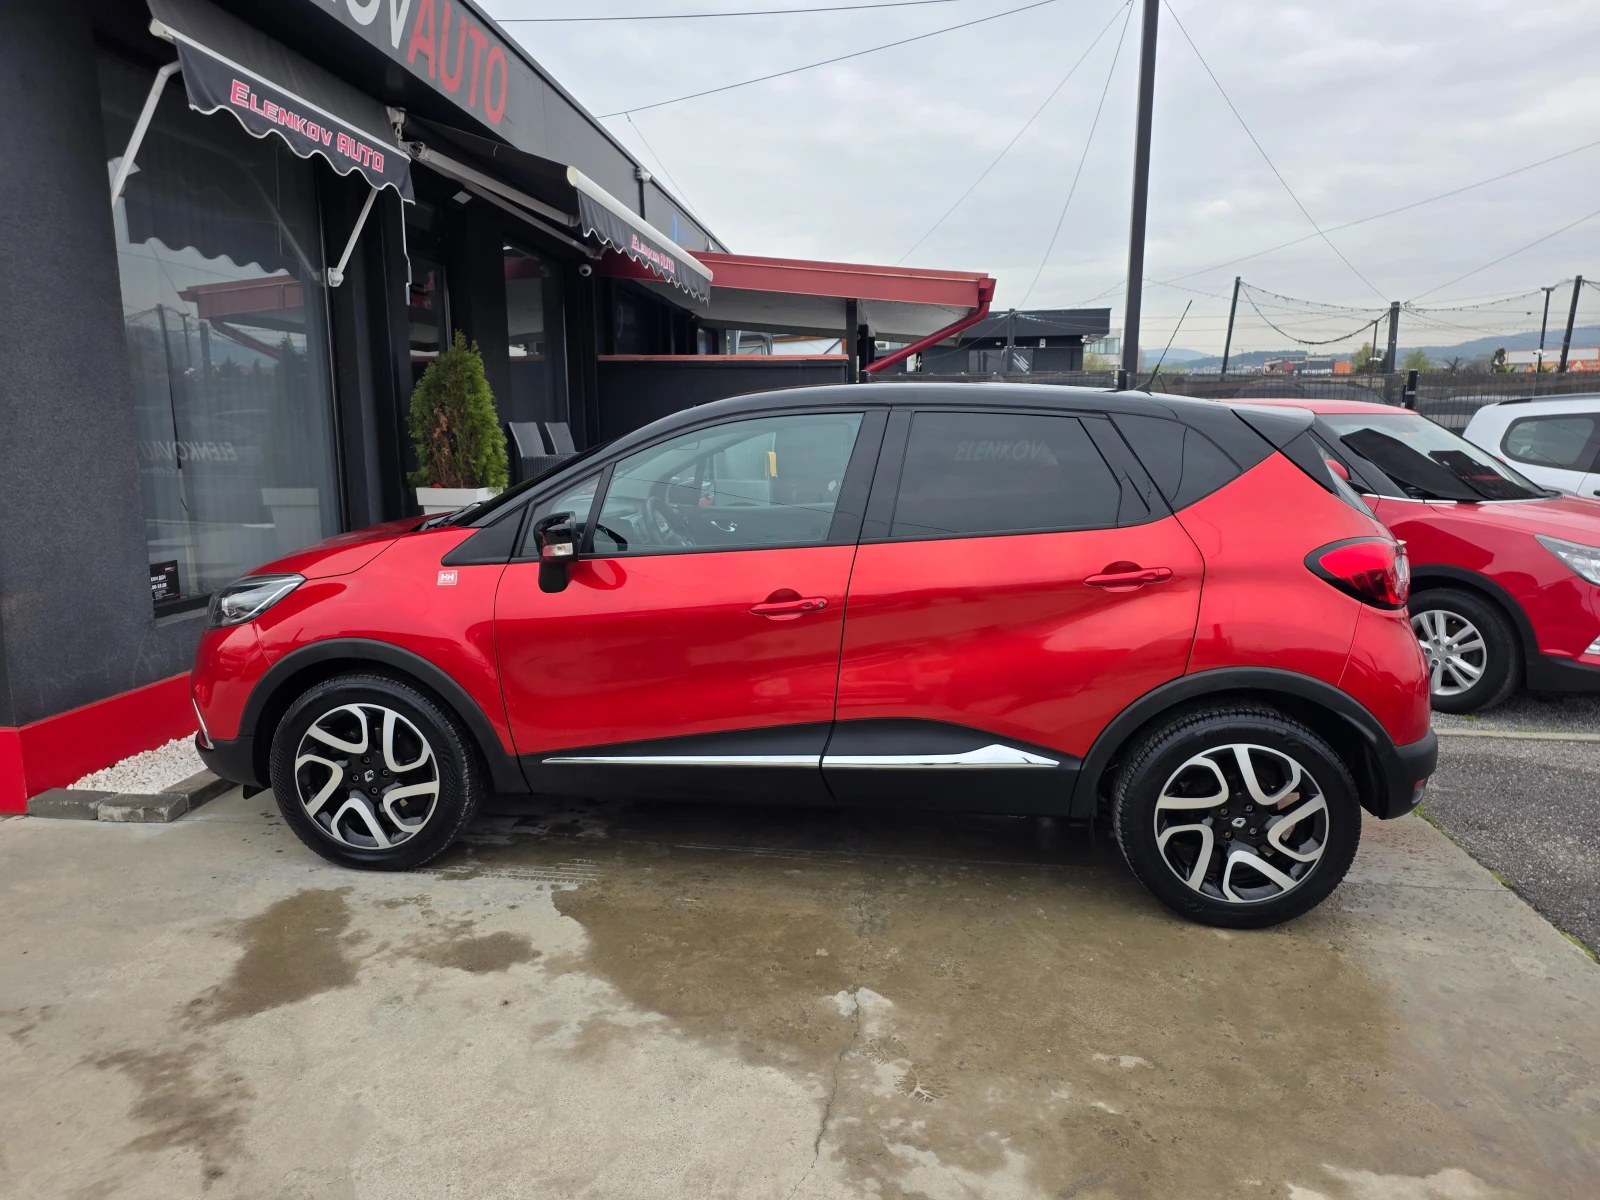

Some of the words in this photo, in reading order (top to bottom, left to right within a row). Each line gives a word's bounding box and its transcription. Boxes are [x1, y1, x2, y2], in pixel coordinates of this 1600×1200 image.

[230, 79, 332, 147] ELENKOV
[336, 132, 385, 173] AUTO
[660, 253, 674, 273] AUTO
[954, 439, 1046, 461] ELENKOV
